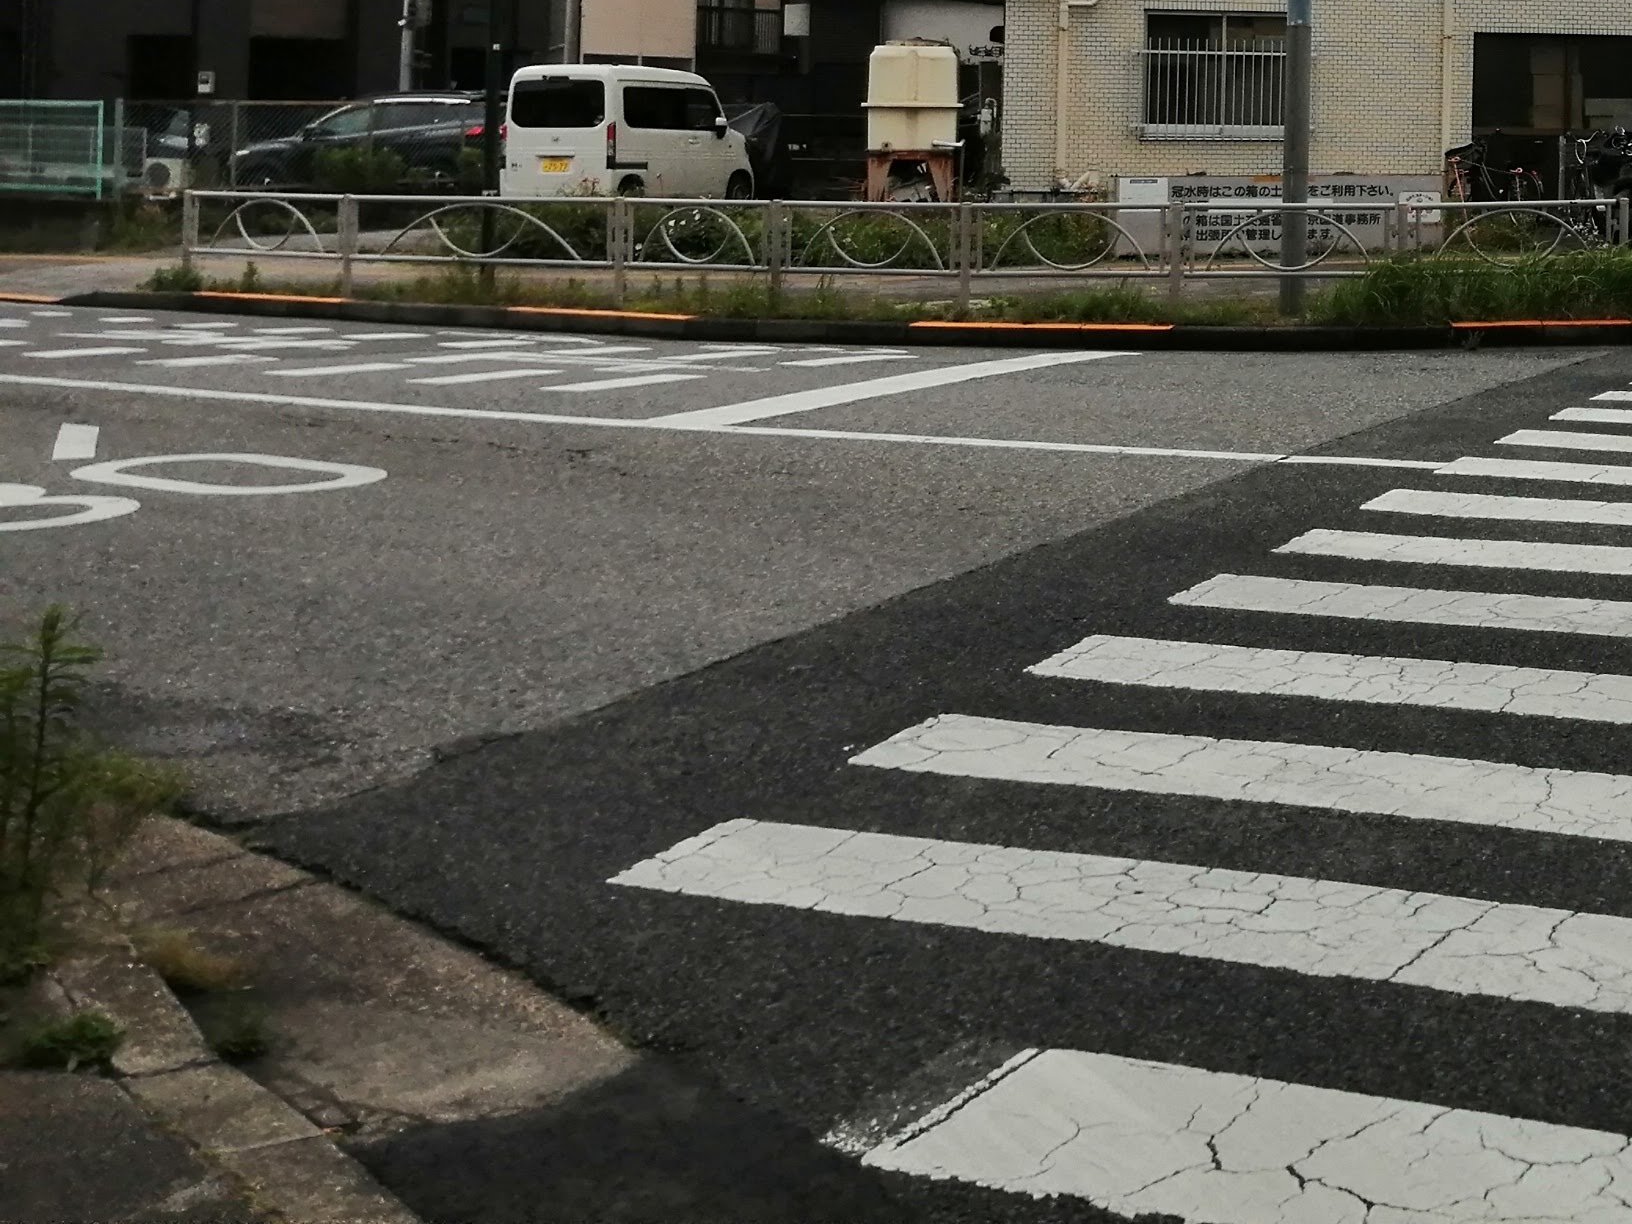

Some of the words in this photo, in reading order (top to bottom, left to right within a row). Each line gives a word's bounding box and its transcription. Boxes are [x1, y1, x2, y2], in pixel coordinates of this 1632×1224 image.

[1171, 185, 1394, 197] 冠水時はこの箱の土をご利用下さい。
